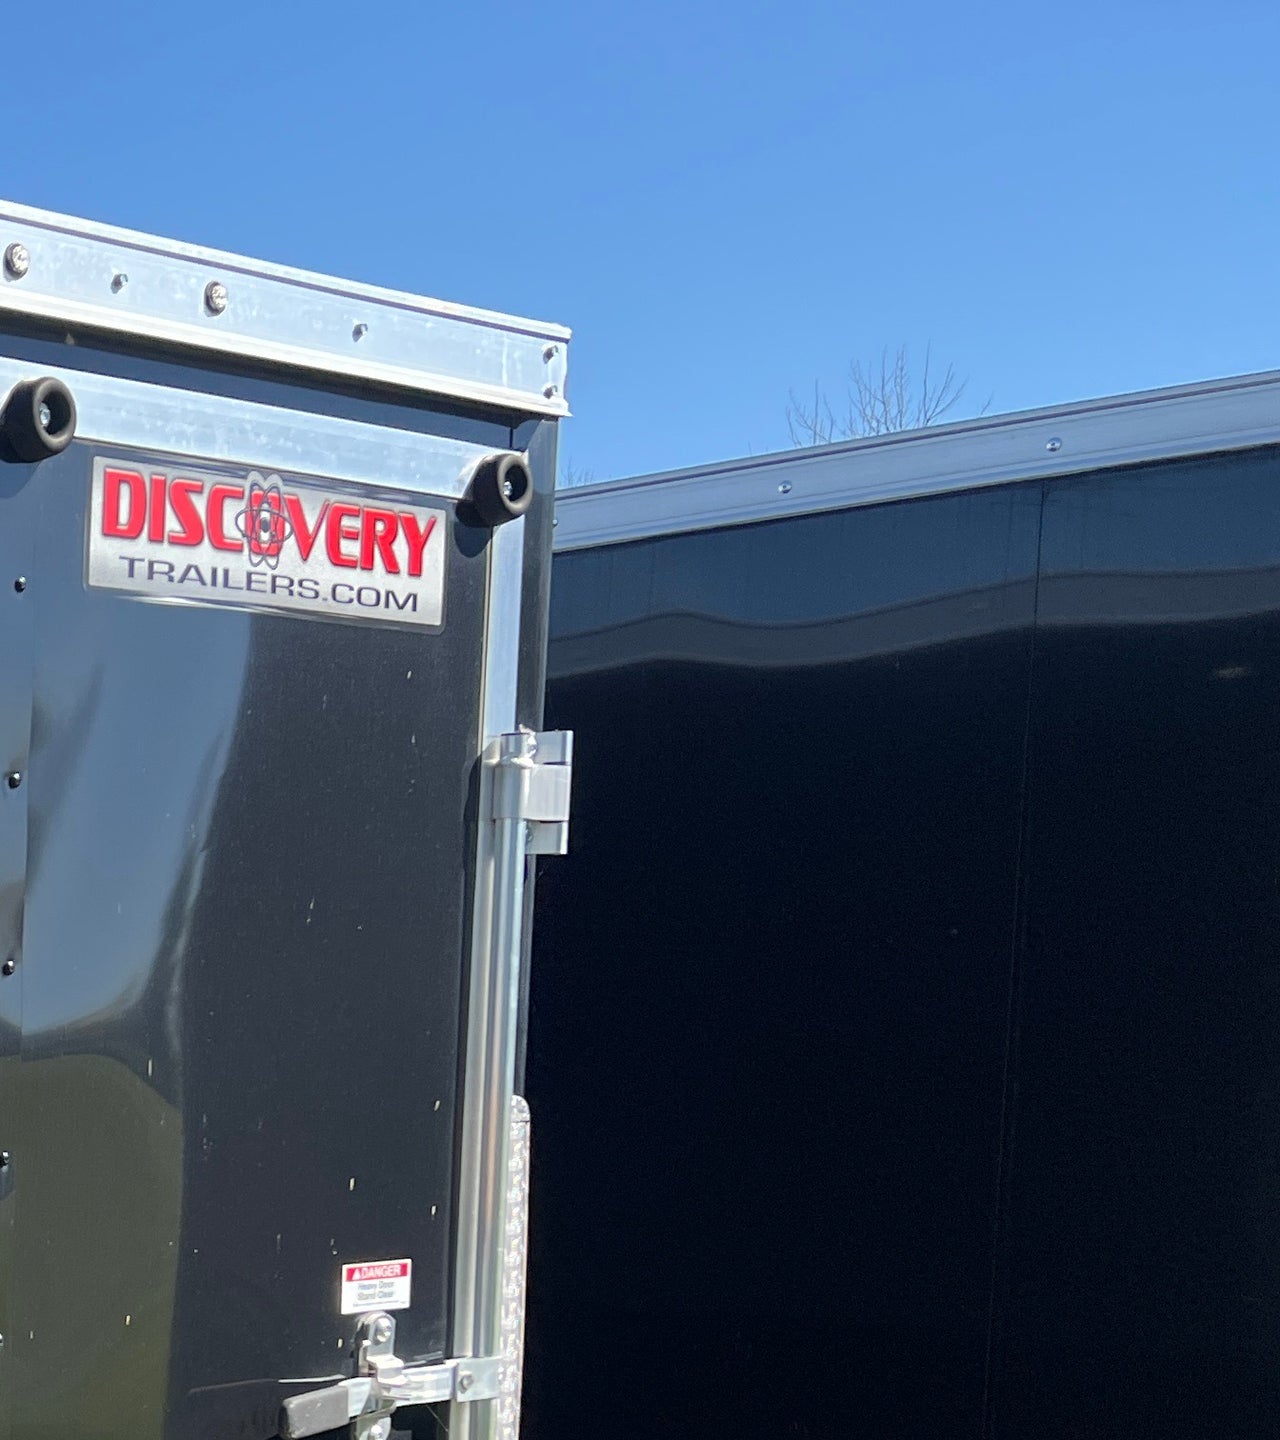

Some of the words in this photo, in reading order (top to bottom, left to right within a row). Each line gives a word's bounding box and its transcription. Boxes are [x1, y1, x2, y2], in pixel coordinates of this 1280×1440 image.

[102, 467, 437, 578] DISCOVERY
[118, 555, 418, 612] TRAILERS.COM
[361, 1264, 400, 1279] DANGER
